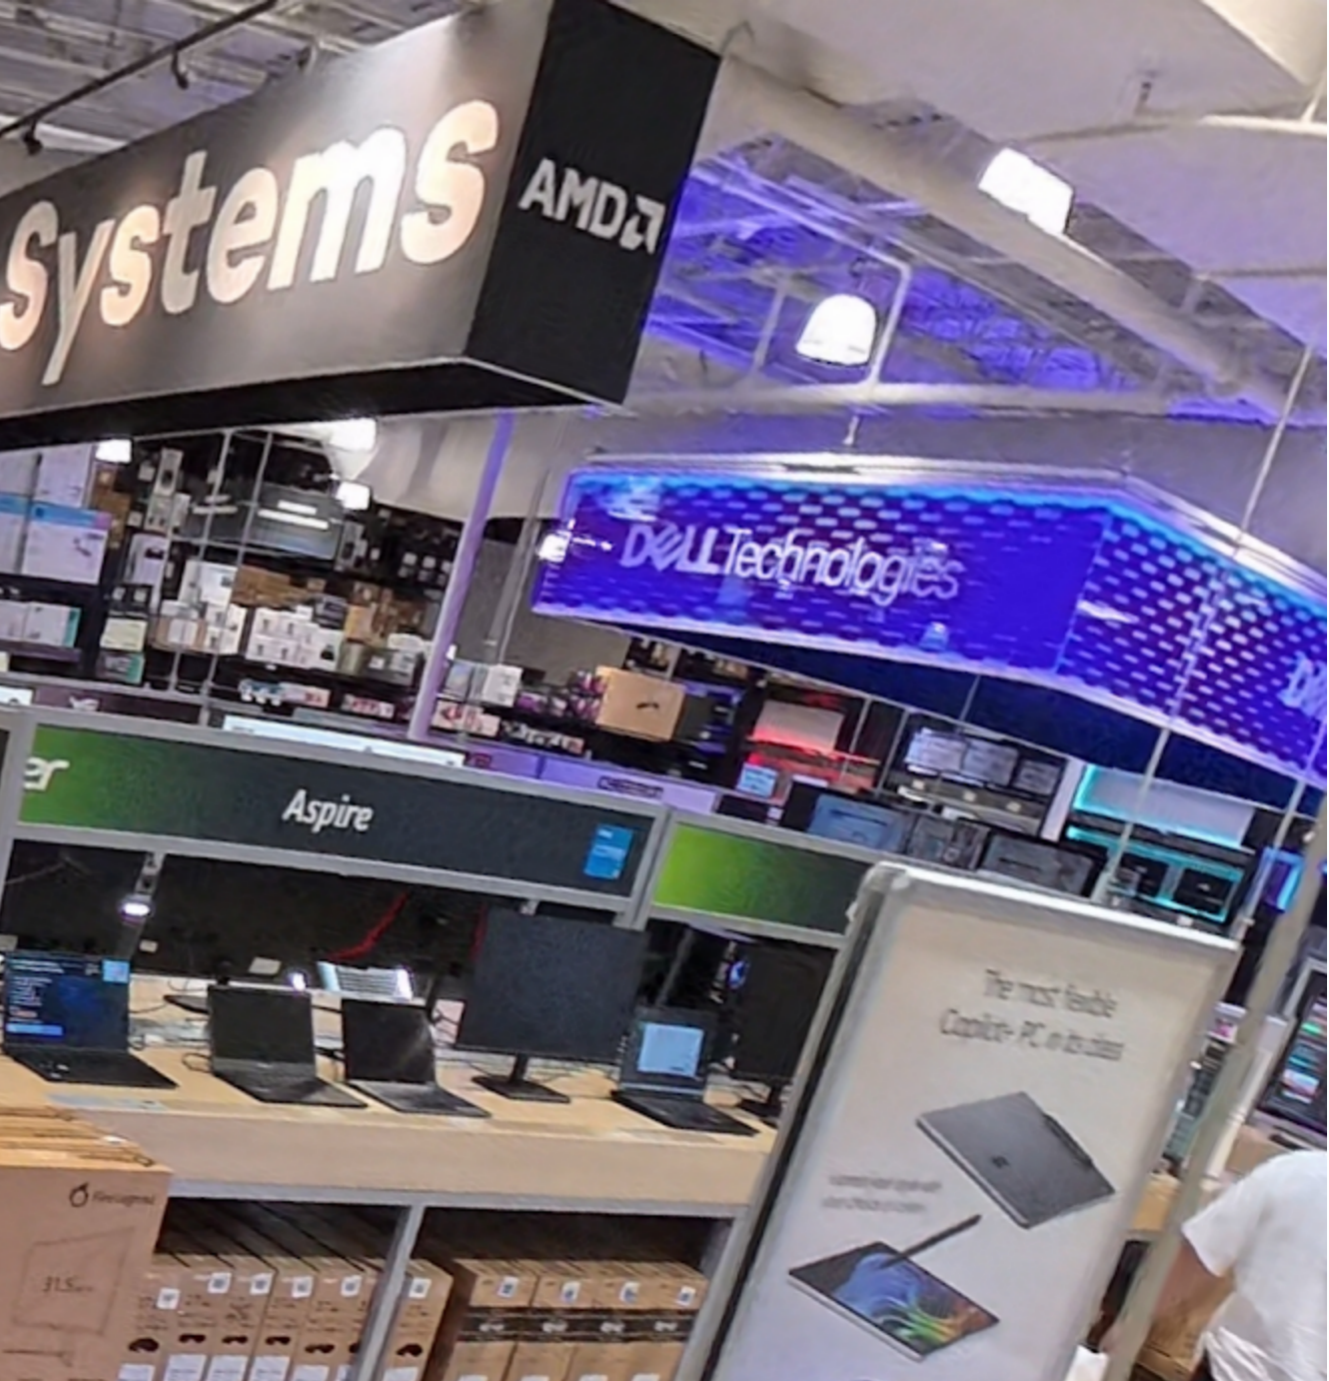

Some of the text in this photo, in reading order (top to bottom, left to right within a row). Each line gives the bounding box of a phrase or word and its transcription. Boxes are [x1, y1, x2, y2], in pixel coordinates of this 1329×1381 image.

[519, 158, 631, 242] AMD
[619, 523, 966, 606] DELL Technologies
[24, 757, 70, 791] er
[282, 789, 374, 833] Aspire
